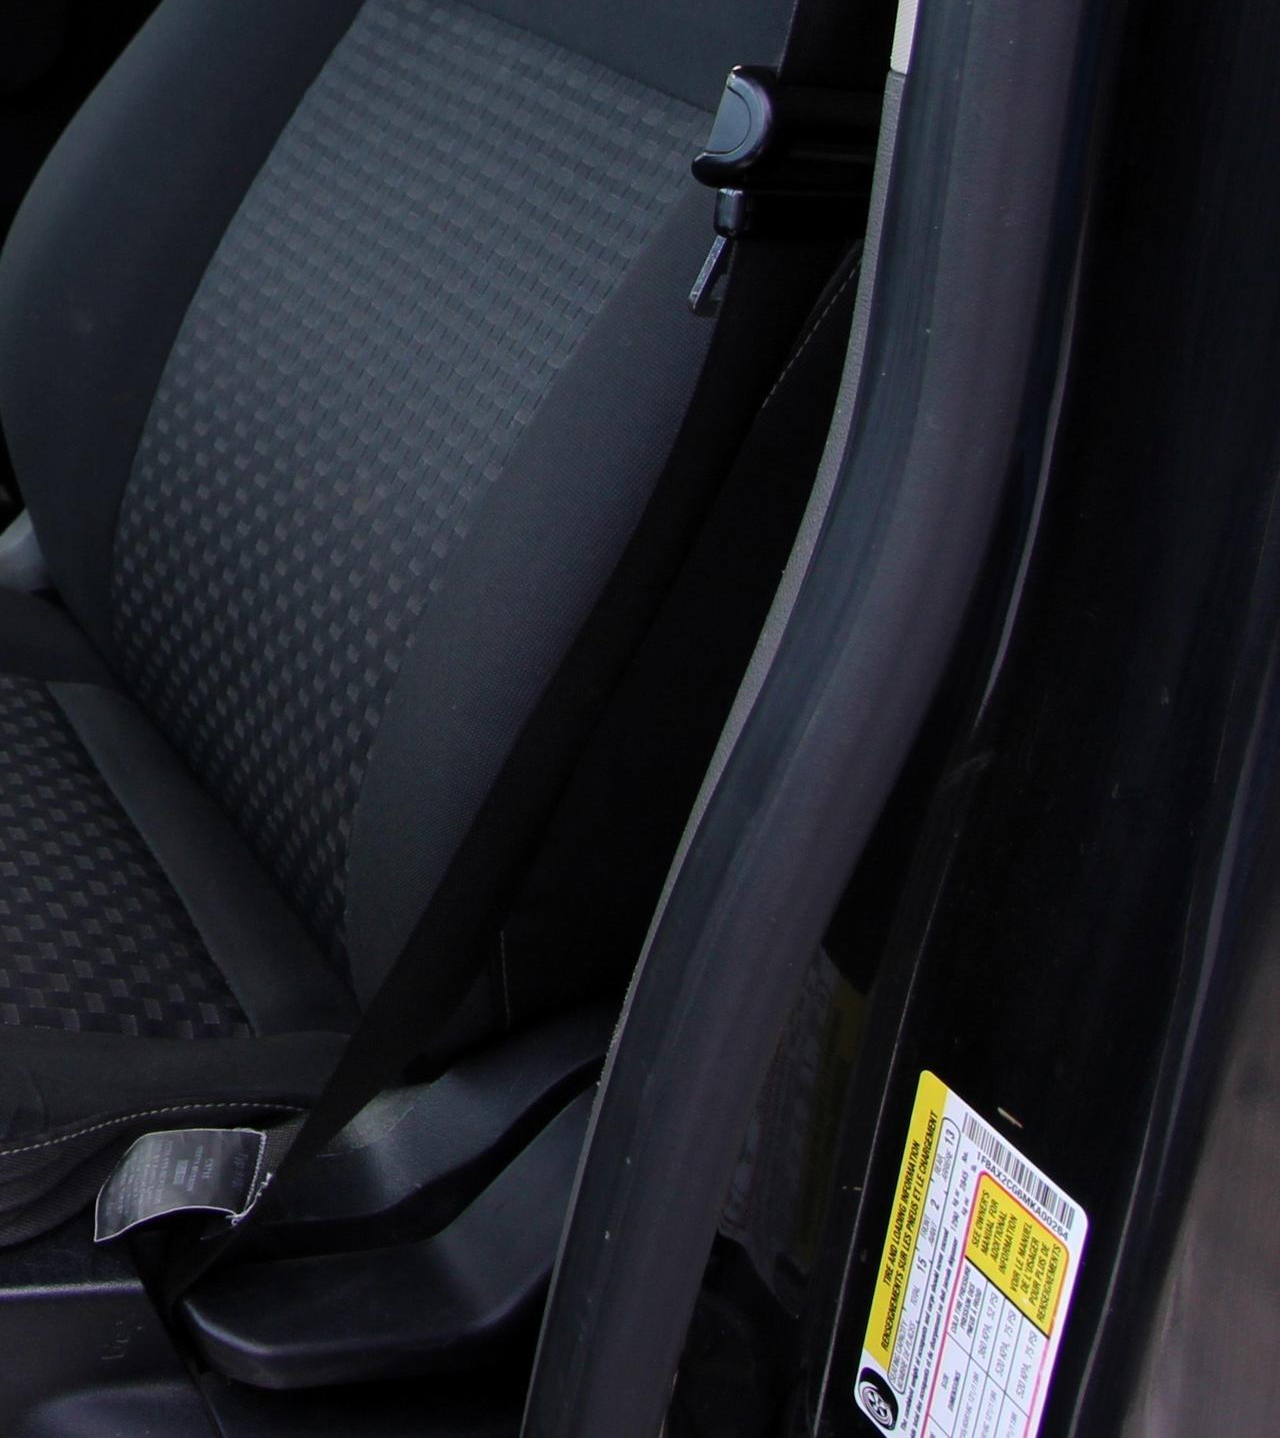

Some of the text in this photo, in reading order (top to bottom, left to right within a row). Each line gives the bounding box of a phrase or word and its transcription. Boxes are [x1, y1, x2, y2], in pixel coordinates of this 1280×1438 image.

[945, 1128, 955, 1146] 13
[880, 1110, 938, 1350] RENSEIGNEMENTS SUR LES PNEUS ET LE CHARGEMENT
[883, 1139, 920, 1286] TIRE AND LOADING INFORMATION
[930, 1198, 939, 1210] 2
[972, 1189, 989, 1247] SEE OWNER'S
[981, 1198, 998, 1255] MANUAL FOR
[916, 1255, 926, 1273] 15
[990, 1210, 1007, 1261] ADDITIONAL
[998, 1213, 1017, 1274] INFORMATION
[1010, 1220, 1031, 1293] VOIR LE MANUEL
[1021, 1236, 1039, 1293] DE L'USAGER
[1029, 1242, 1049, 1306] POUR PLUS DE
[1037, 1243, 1061, 1323] RENSEIGNEMENTS
